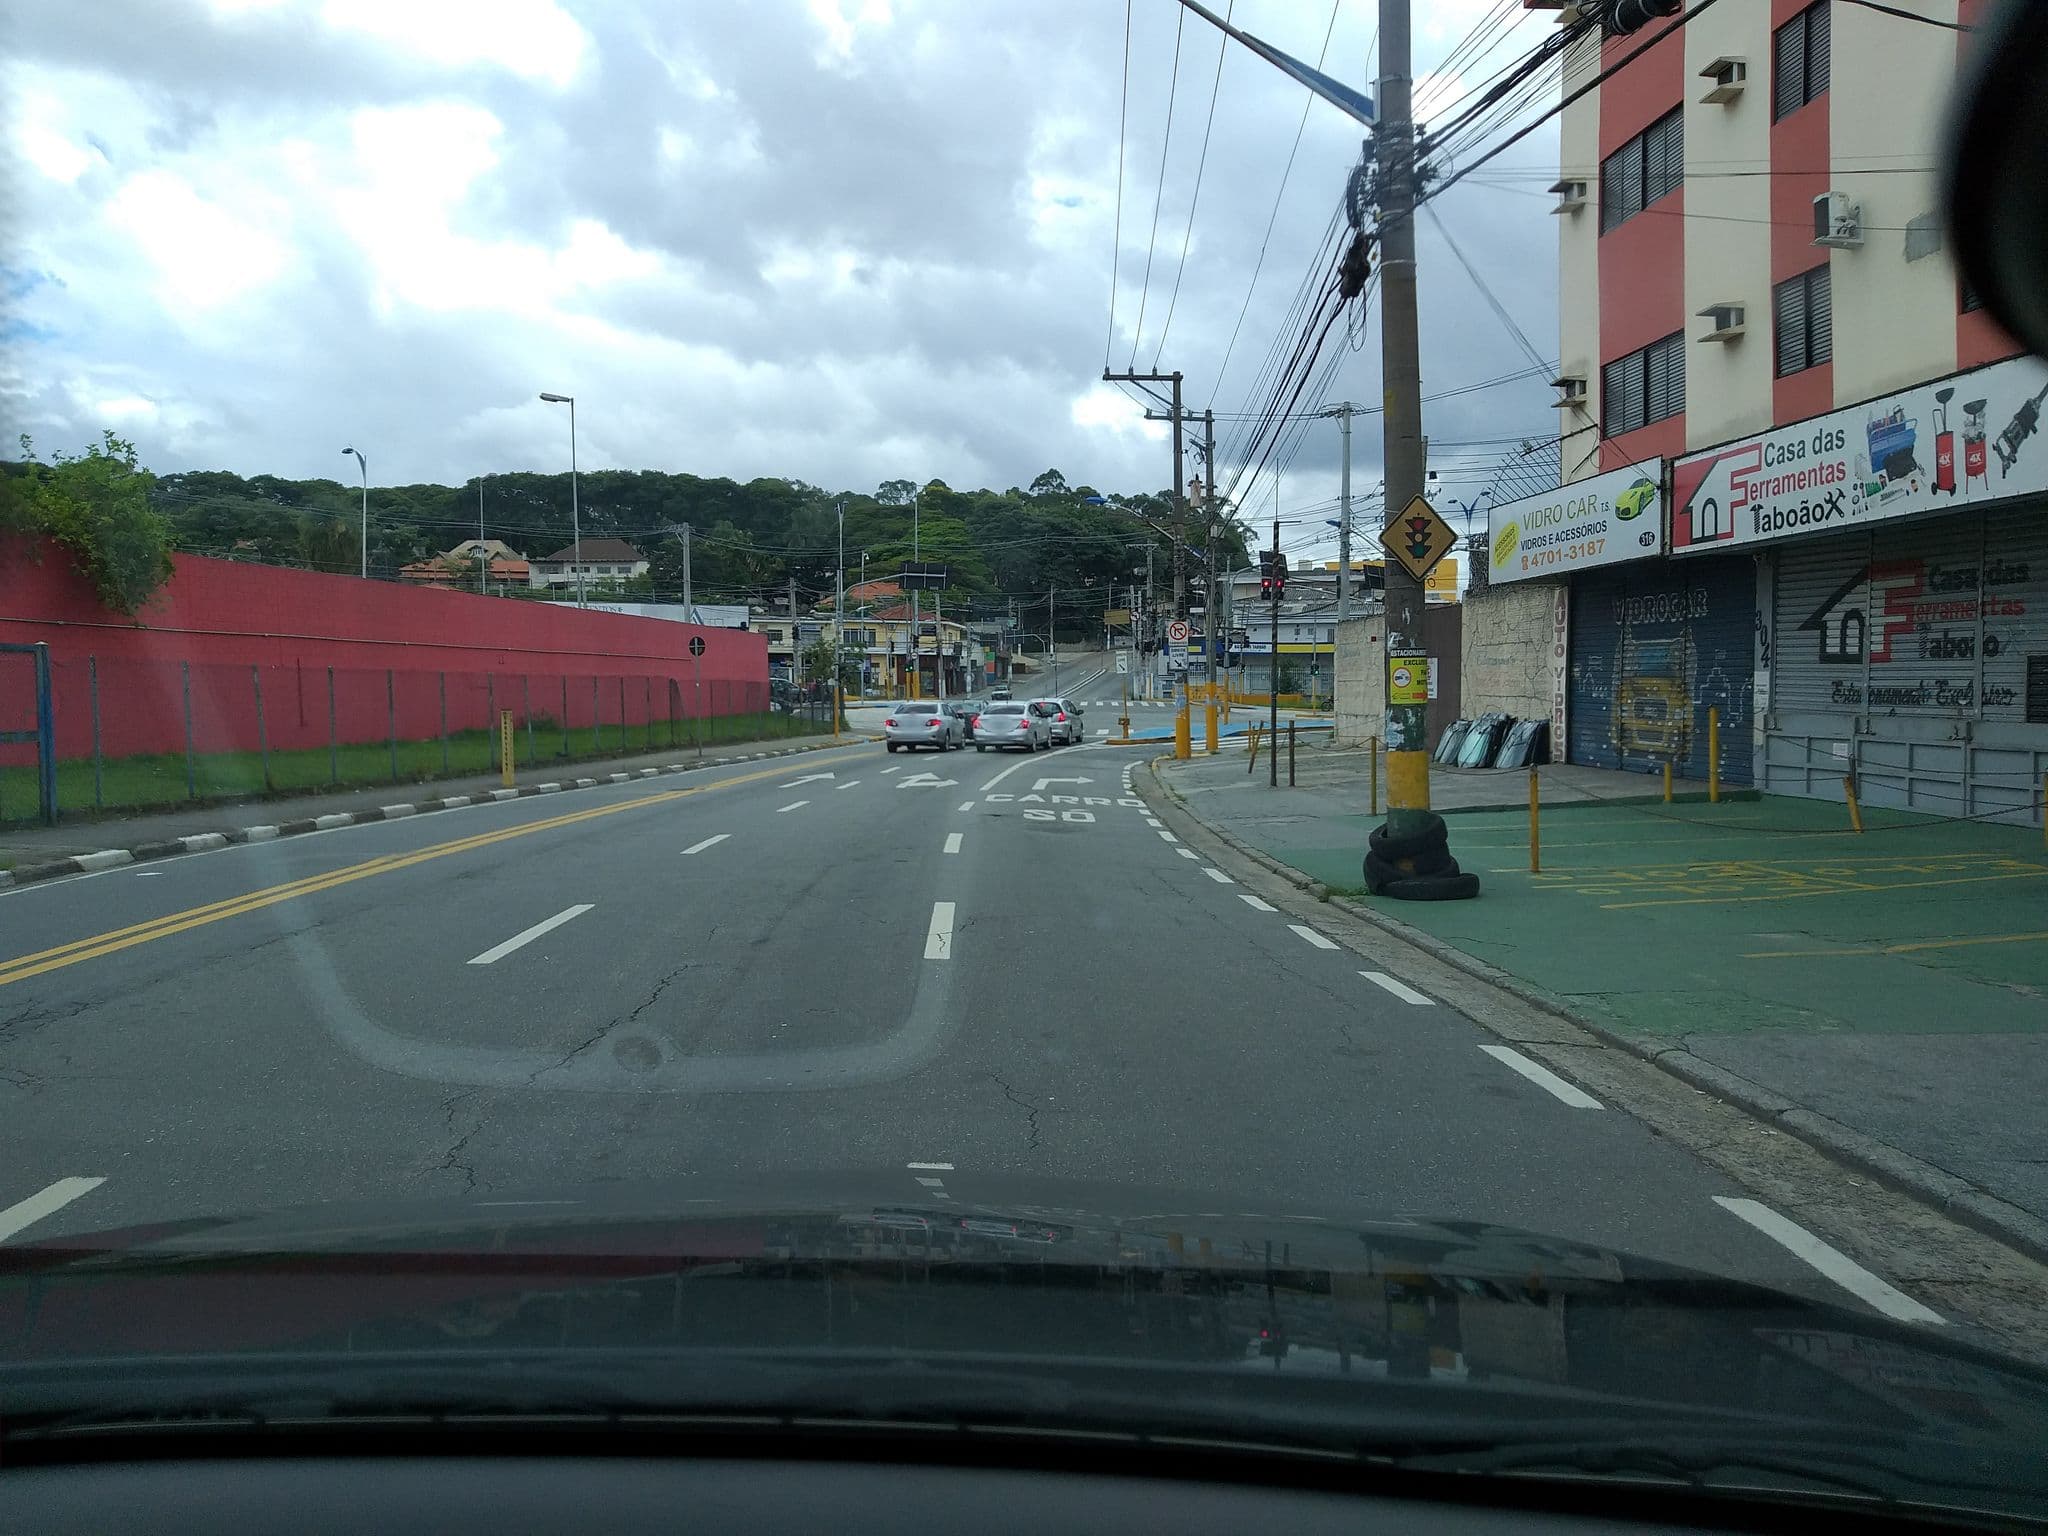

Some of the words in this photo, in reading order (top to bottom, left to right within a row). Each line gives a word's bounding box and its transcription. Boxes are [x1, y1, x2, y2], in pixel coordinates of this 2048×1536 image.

[1764, 442, 1806, 468] Casa
[1812, 428, 1845, 454] das
[1523, 503, 1563, 531] VIDRO
[1566, 494, 1598, 520] CAR
[1520, 535, 1547, 552] VIDROS
[1549, 533, 1554, 545] E
[1554, 520, 1608, 543] ACESSÓRIOS
[1641, 532, 1654, 545] 316
[1531, 538, 1606, 568] 4701-3187
[1554, 590, 1566, 659] AUTO
[1755, 610, 1771, 668] 304
[985, 793, 1147, 808] CARRO
[1023, 808, 1097, 823] SÓ
